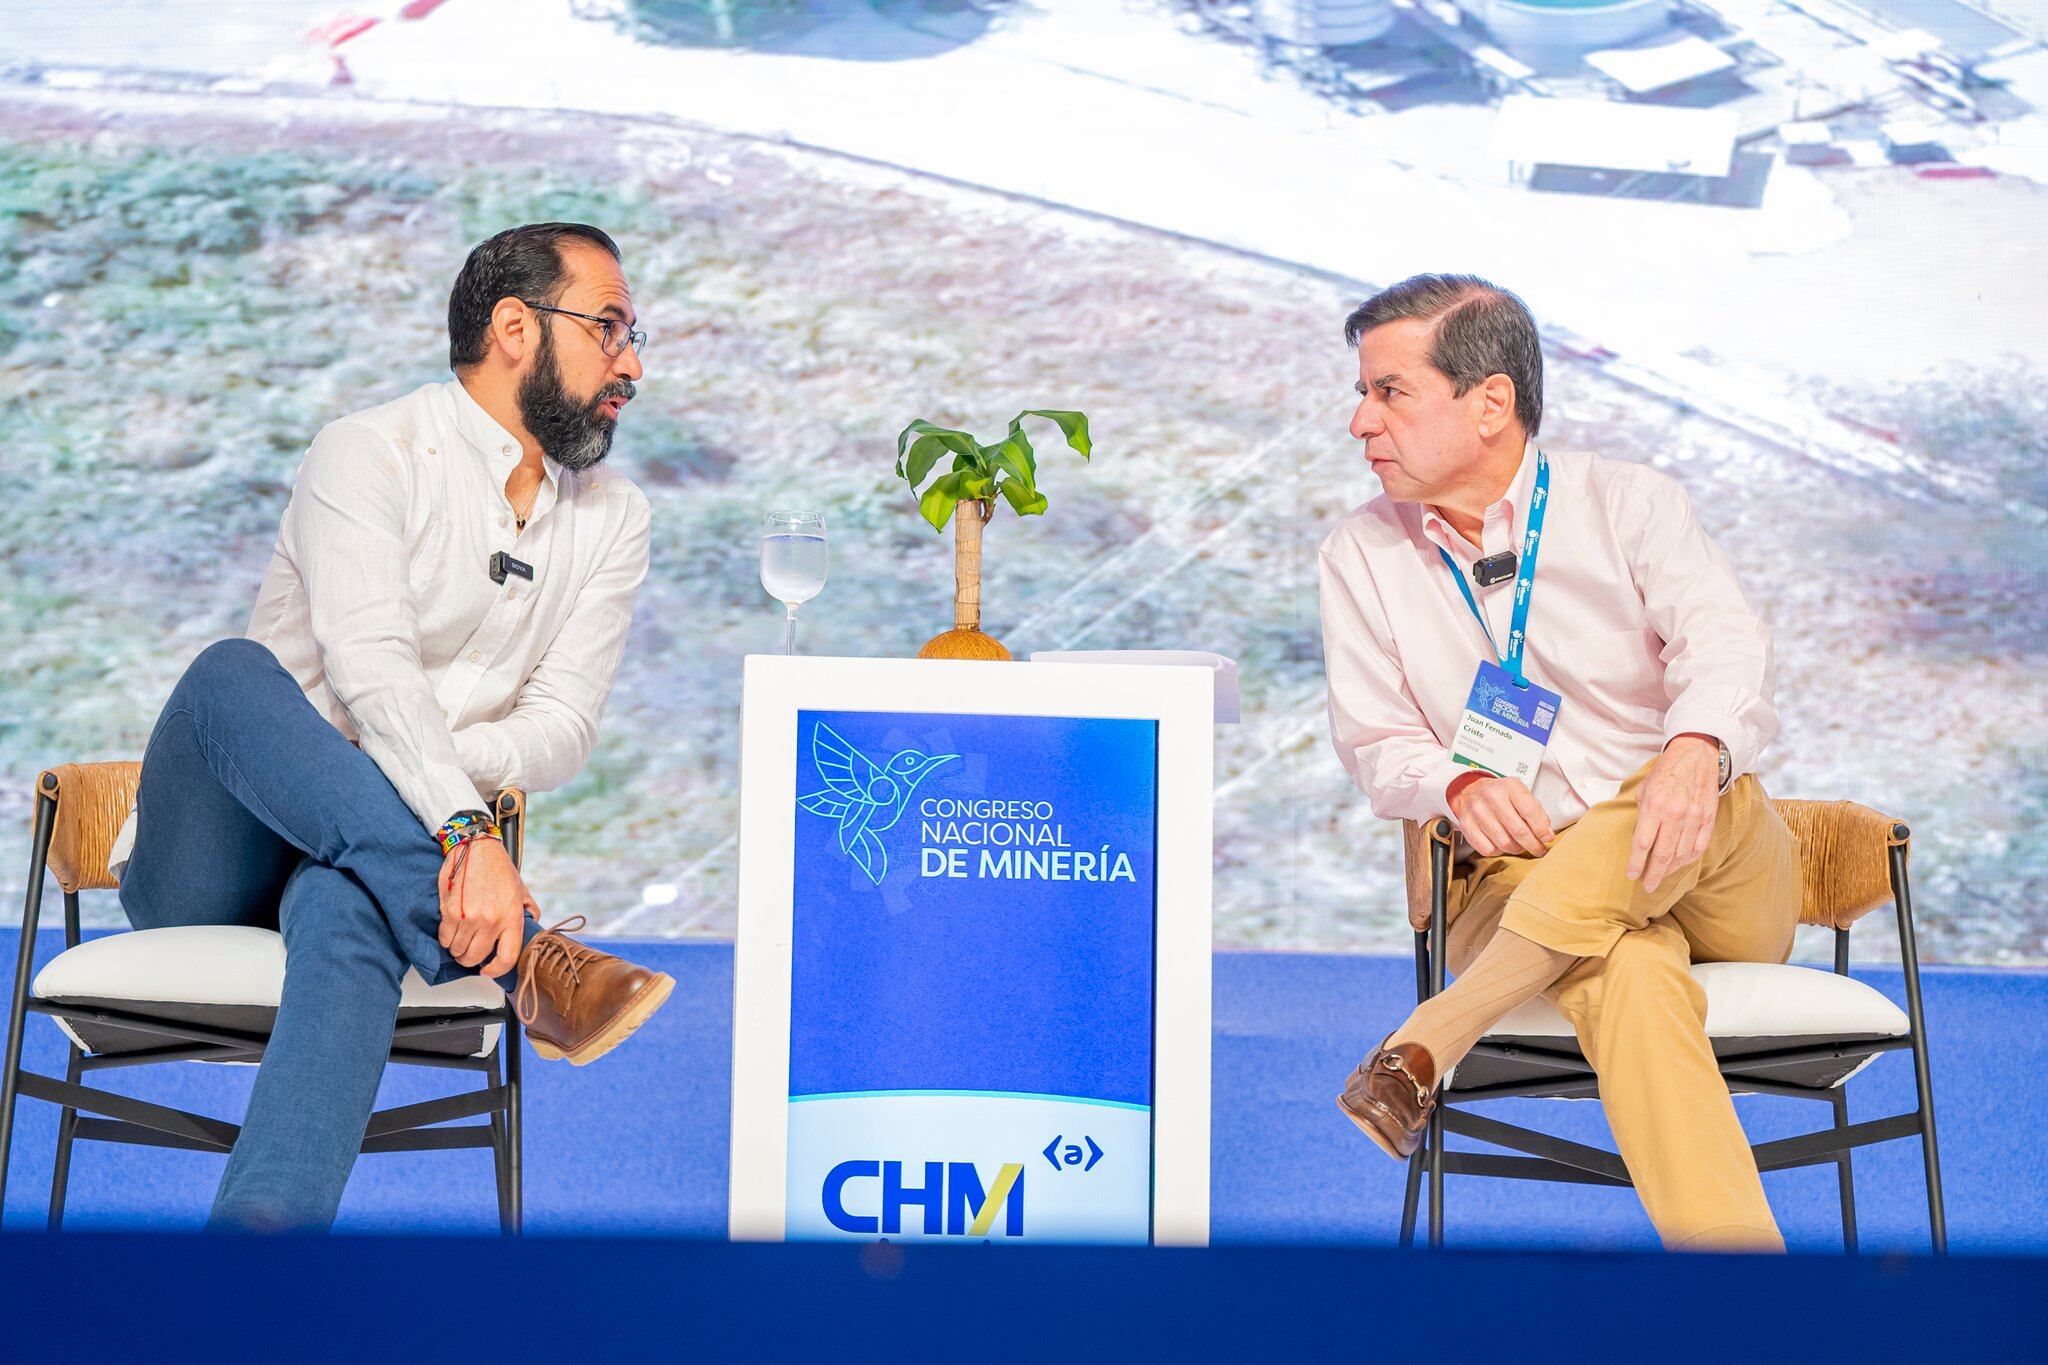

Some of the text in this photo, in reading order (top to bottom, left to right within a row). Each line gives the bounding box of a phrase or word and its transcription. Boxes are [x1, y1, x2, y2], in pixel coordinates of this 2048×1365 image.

[511, 562, 527, 573] BOYA
[1491, 706, 1501, 716] DE
[1493, 701, 1520, 716] NACIONAL
[1466, 714, 1484, 727] Juan
[1463, 724, 1484, 739] Cristo
[921, 798, 1054, 820] CONGRESO
[921, 821, 1072, 847] NACIONAL
[921, 844, 1137, 882] DE MINERÍA
[822, 1160, 1025, 1237] CHM
